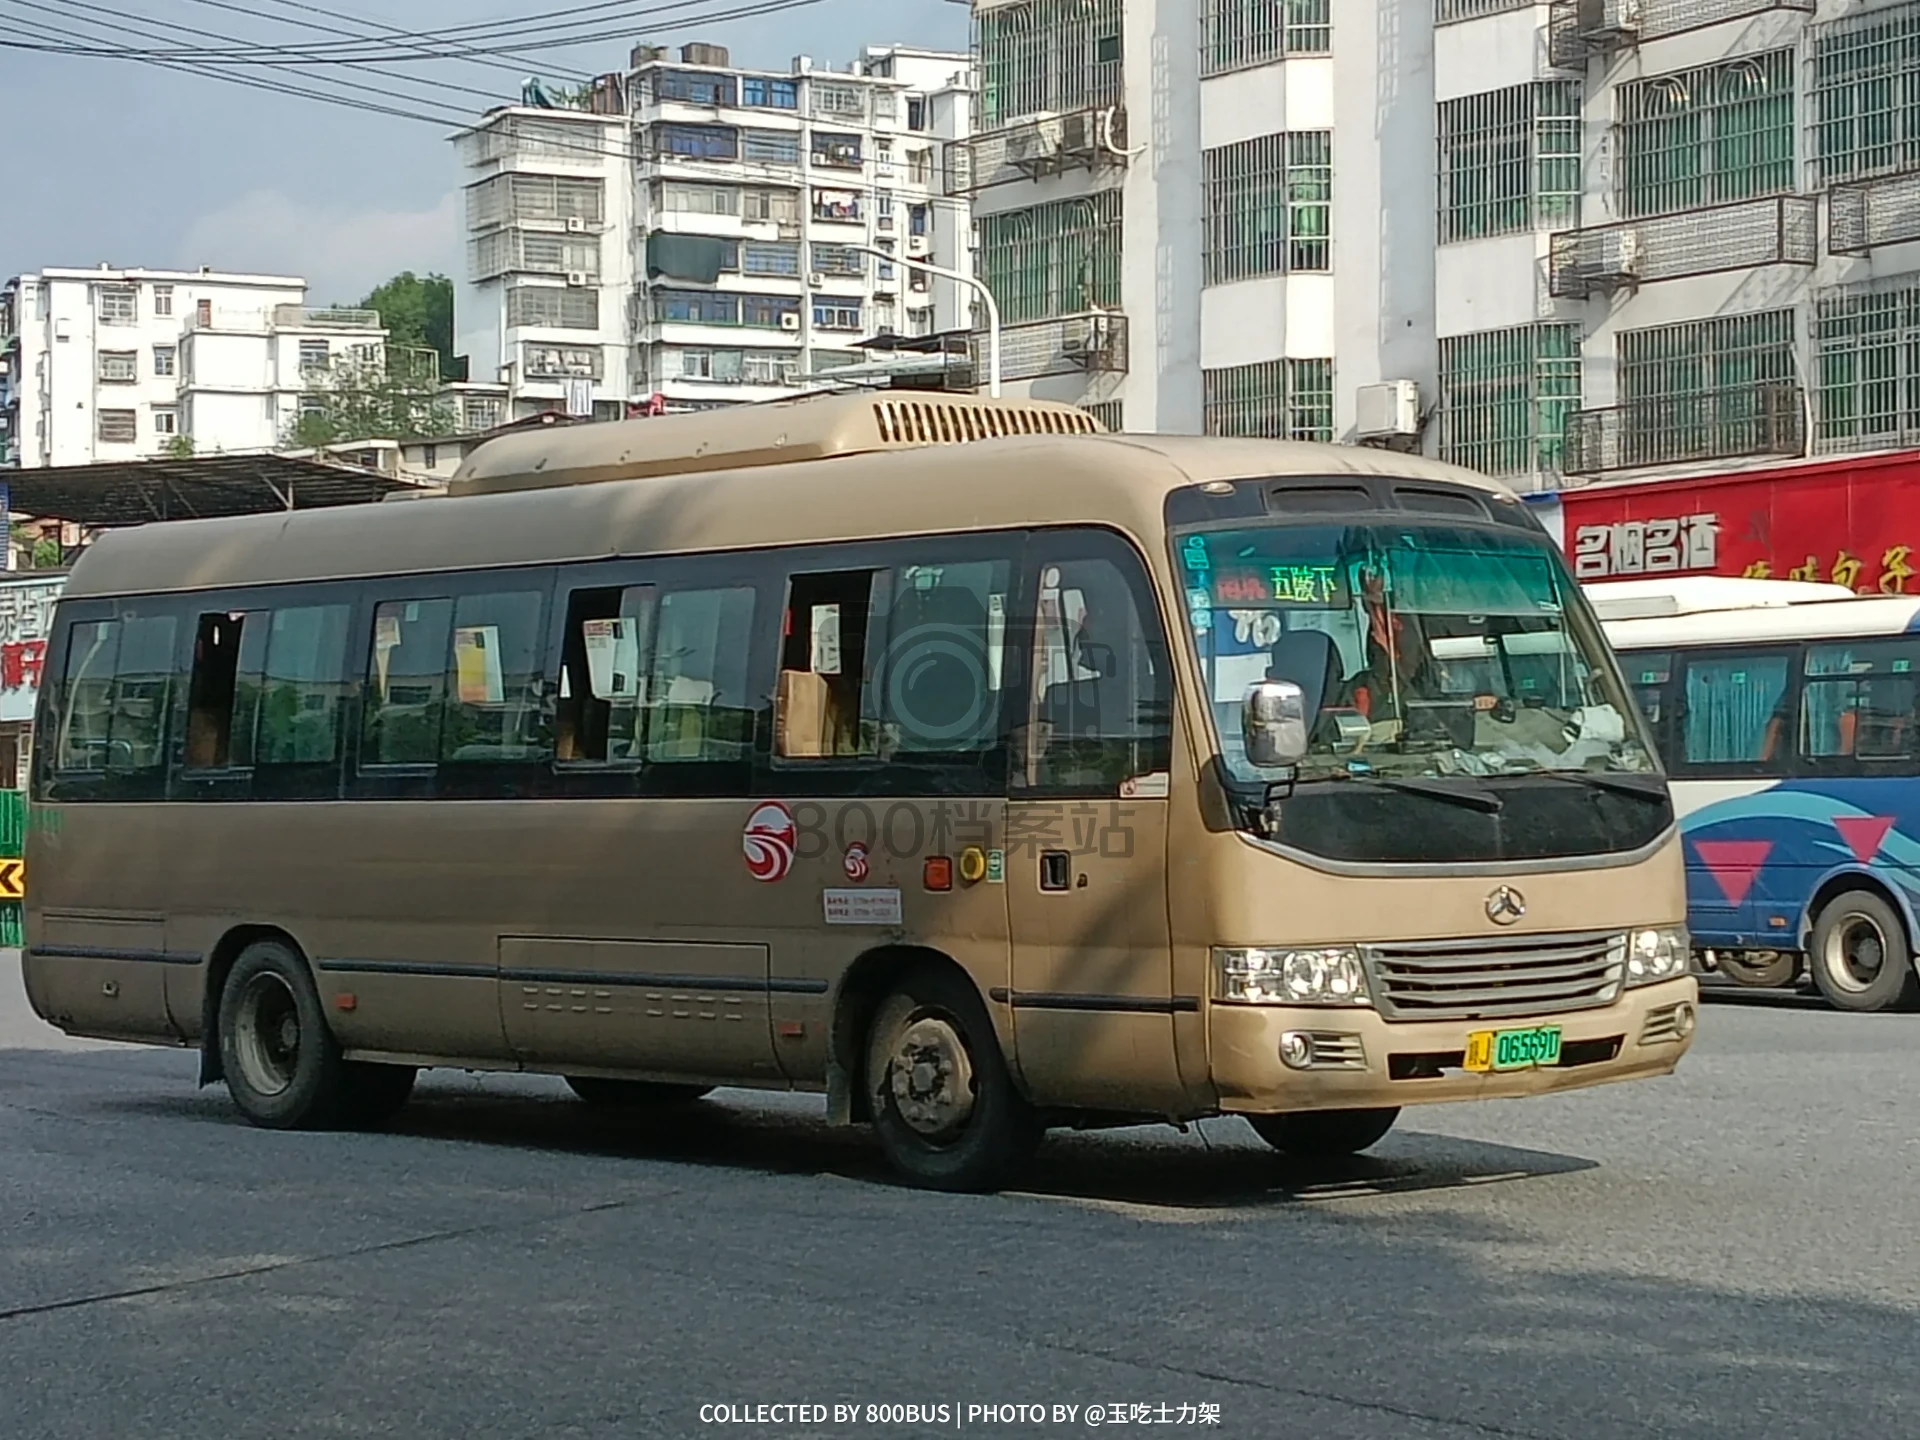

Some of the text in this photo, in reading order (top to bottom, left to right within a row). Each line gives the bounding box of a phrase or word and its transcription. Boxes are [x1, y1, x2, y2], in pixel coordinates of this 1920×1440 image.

[1575, 513, 1719, 578] 名烟名酒
[1270, 565, 1338, 602] 五陂下
